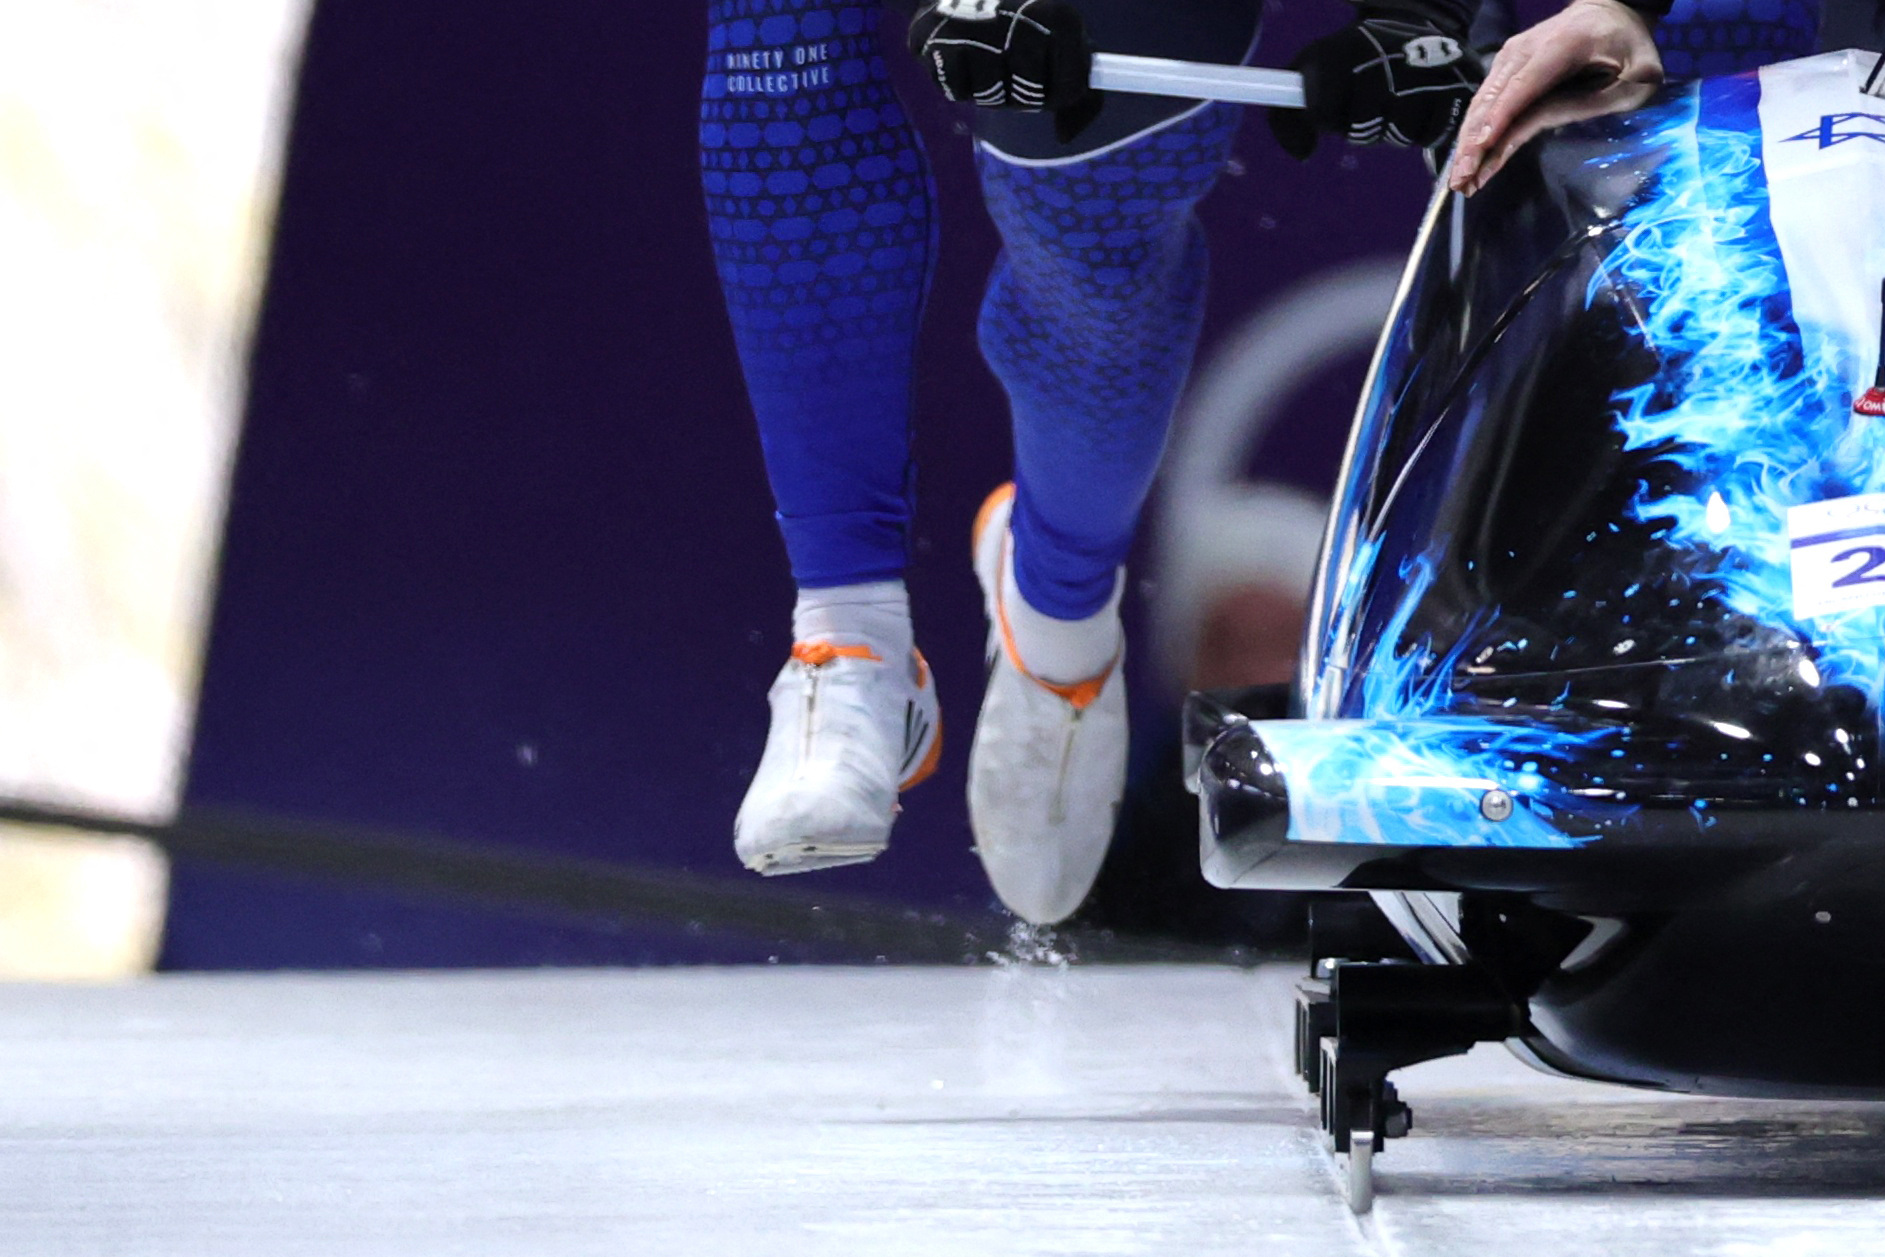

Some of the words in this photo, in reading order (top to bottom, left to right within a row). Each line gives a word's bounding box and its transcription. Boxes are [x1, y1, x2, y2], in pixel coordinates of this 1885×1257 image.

[727, 48, 785, 70] NINETY
[795, 43, 829, 65] ONE
[727, 66, 830, 93] COLLECTIVE
